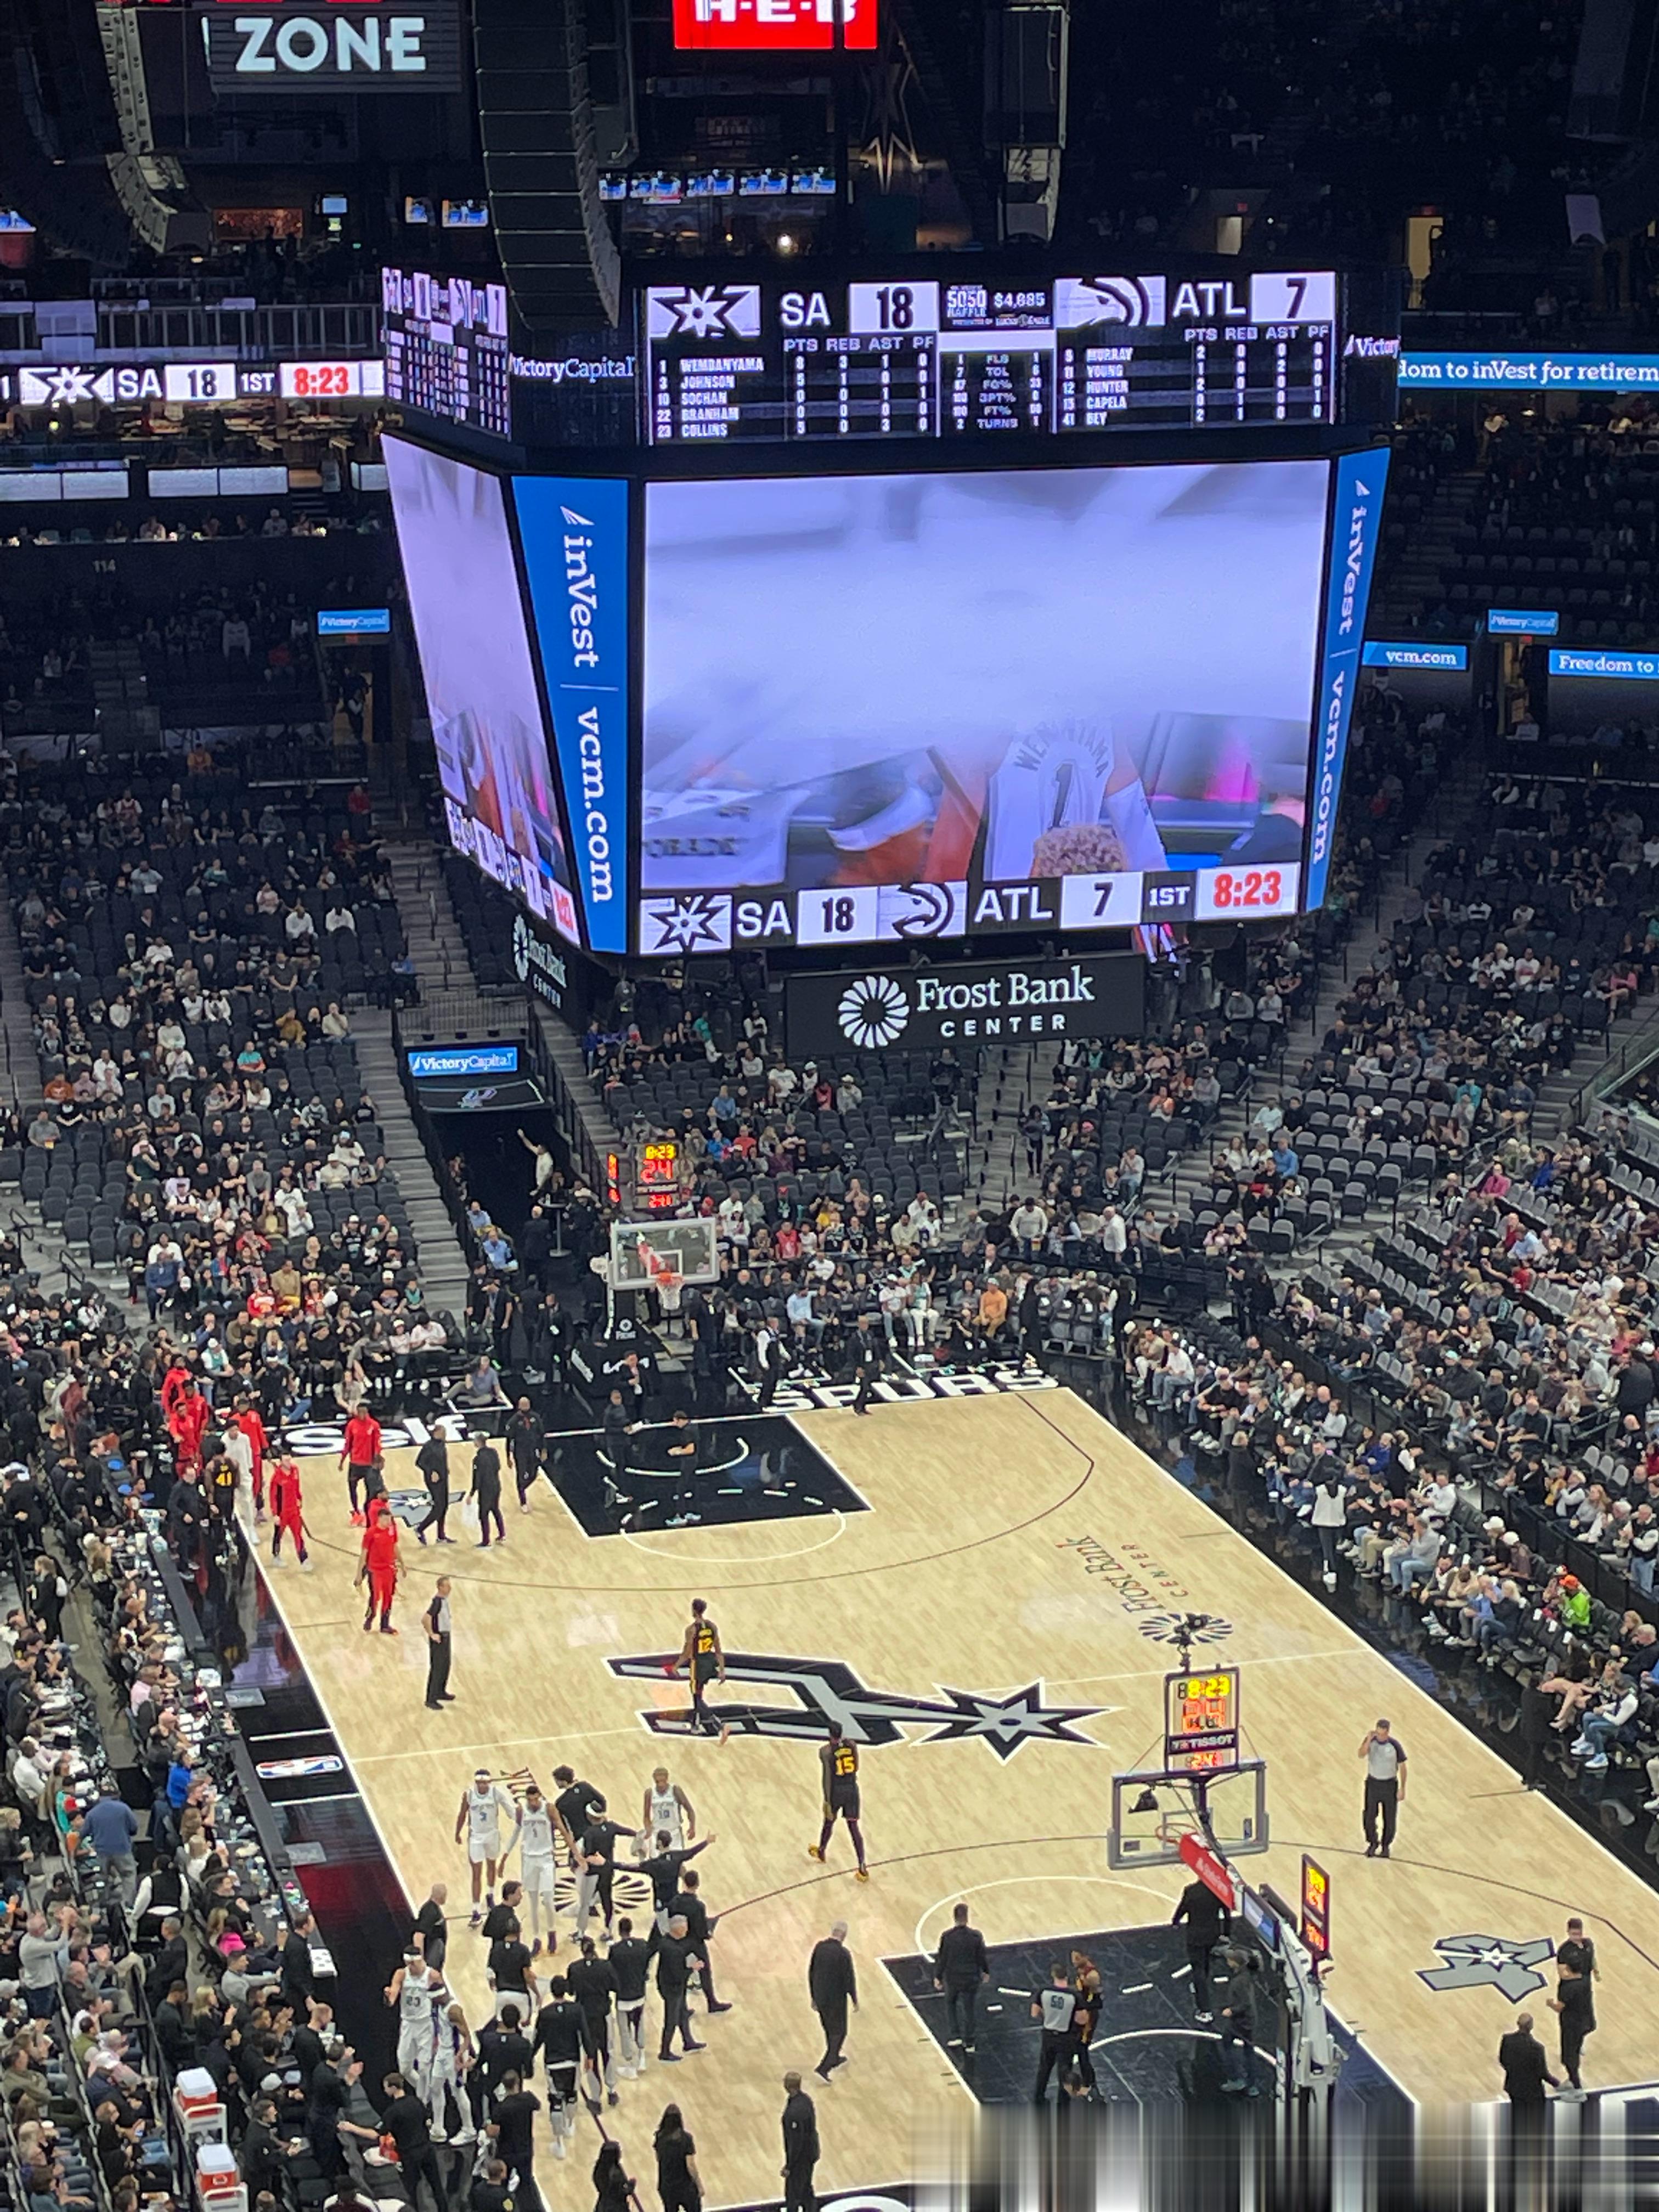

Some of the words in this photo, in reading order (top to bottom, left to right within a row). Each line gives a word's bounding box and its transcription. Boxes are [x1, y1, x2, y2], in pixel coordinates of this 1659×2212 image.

[234, 17, 426, 72] ZONE
[781, 292, 830, 327] SA
[877, 286, 913, 330] 18
[1172, 282, 1246, 318] ATL
[1285, 278, 1308, 319] 7
[784, 337, 818, 352] PTS
[826, 337, 861, 351] REB
[868, 336, 904, 351] AST
[913, 335, 934, 349] PF
[1184, 328, 1218, 342] PTS
[1266, 326, 1300, 339] AST
[1307, 325, 1329, 338] PF
[1196, 345, 1205, 359] 2
[1237, 344, 1246, 357] 0
[1277, 342, 1286, 357] 0
[1314, 341, 1323, 355] 0
[513, 356, 635, 383] VictoryCapital
[659, 360, 667, 374] 1
[839, 356, 848, 369] 3
[881, 354, 890, 368] 1
[919, 353, 928, 366] 0
[986, 367, 1009, 377] TOL
[1086, 364, 1124, 377] YOUNG
[1196, 362, 1205, 375] 1
[1237, 360, 1246, 374] 0
[1277, 360, 1286, 373] 2
[1314, 358, 1323, 371] 0
[1446, 363, 1468, 379] to
[1472, 360, 1536, 379] inVest
[1541, 361, 1572, 385] for
[1577, 362, 1659, 381] retirem
[118, 370, 161, 398] SA
[188, 369, 217, 398] 18
[242, 372, 273, 392] 1ST
[294, 366, 349, 394] 8:23
[659, 376, 668, 390] 3
[680, 375, 735, 389] JOHNSON
[796, 373, 805, 386] 5
[839, 373, 848, 385] 1
[881, 371, 890, 383] 0
[919, 370, 928, 383] 0
[1063, 381, 1075, 394] 12
[1086, 380, 1129, 394] HUNTER
[1196, 377, 1205, 390] 2
[1237, 376, 1246, 389] 0
[1277, 375, 1286, 388] 0
[1314, 374, 1323, 387] 0
[658, 393, 670, 406] 10
[681, 392, 727, 405] SOCHAN
[796, 390, 805, 402] 0
[839, 388, 848, 400] 0
[881, 387, 890, 399] 1
[919, 386, 928, 398] 1
[979, 392, 1017, 403] 3PT%
[1086, 396, 1127, 409] CAPELA
[1196, 393, 1205, 406] 0
[1237, 392, 1246, 405] 1
[1277, 390, 1286, 403] 0
[1314, 390, 1323, 402] 1
[657, 409, 672, 422] 22
[796, 405, 805, 417] 0
[839, 404, 848, 416] 0
[881, 402, 890, 416] 0
[919, 402, 928, 415] 0
[984, 405, 1012, 416] FT%
[1063, 413, 1075, 426] 41
[1196, 409, 1205, 421] 2
[1237, 407, 1246, 421] 1
[1277, 406, 1286, 419] 0
[1314, 404, 1323, 417] 0
[681, 423, 728, 437] COLLINS
[796, 421, 805, 434] 5
[839, 420, 848, 432] 0
[881, 419, 890, 431] 3
[919, 417, 928, 430] 0
[93, 560, 116, 573] 114
[1339, 505, 1369, 636] inVest
[564, 534, 600, 668] inVest
[1385, 650, 1457, 665] vcm.com
[1559, 655, 1633, 673] Freedom
[1637, 659, 1654, 674] to
[1313, 670, 1345, 864] vcm.com
[577, 705, 614, 904] vcm.com
[735, 900, 793, 937] SA
[821, 896, 855, 933] 18
[974, 887, 1053, 923] ATL
[1093, 882, 1113, 918] 7
[1149, 885, 1190, 907] 1ST
[1212, 870, 1282, 907] 8:23
[916, 978, 1002, 1013] Frost
[1007, 964, 1096, 1006] Bank
[940, 1013, 1066, 1038] CENTER
[421, 1053, 514, 1071] VictoryCapital
[640, 1159, 672, 1184] 24
[761, 1368, 1059, 1413] SPURS
[215, 1471, 232, 1487] 41
[1121, 1543, 1189, 1598] CENTER
[1188, 1675, 1230, 1699] 8:23
[1190, 1734, 1234, 1748] TISSOT
[836, 1756, 855, 1776] 15
